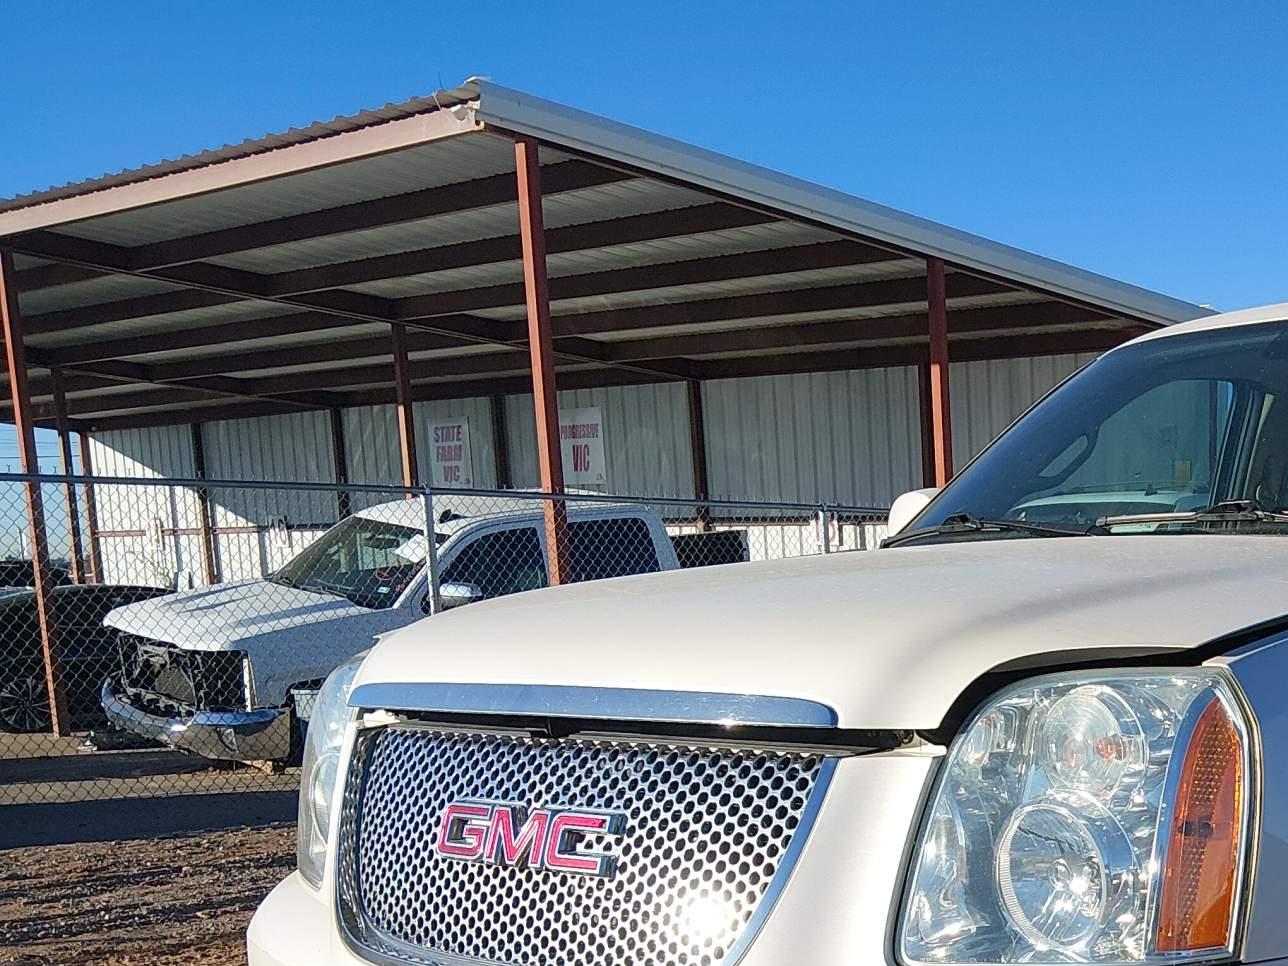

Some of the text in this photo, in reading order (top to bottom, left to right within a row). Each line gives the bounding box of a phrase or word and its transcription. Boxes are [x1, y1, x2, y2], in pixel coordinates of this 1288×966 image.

[433, 425, 463, 443] STATE
[560, 423, 599, 440] PROGRESSIVE
[436, 445, 463, 463] FARM
[572, 443, 590, 472] VIC
[443, 465, 460, 483] VIC
[437, 799, 624, 878] GMC
